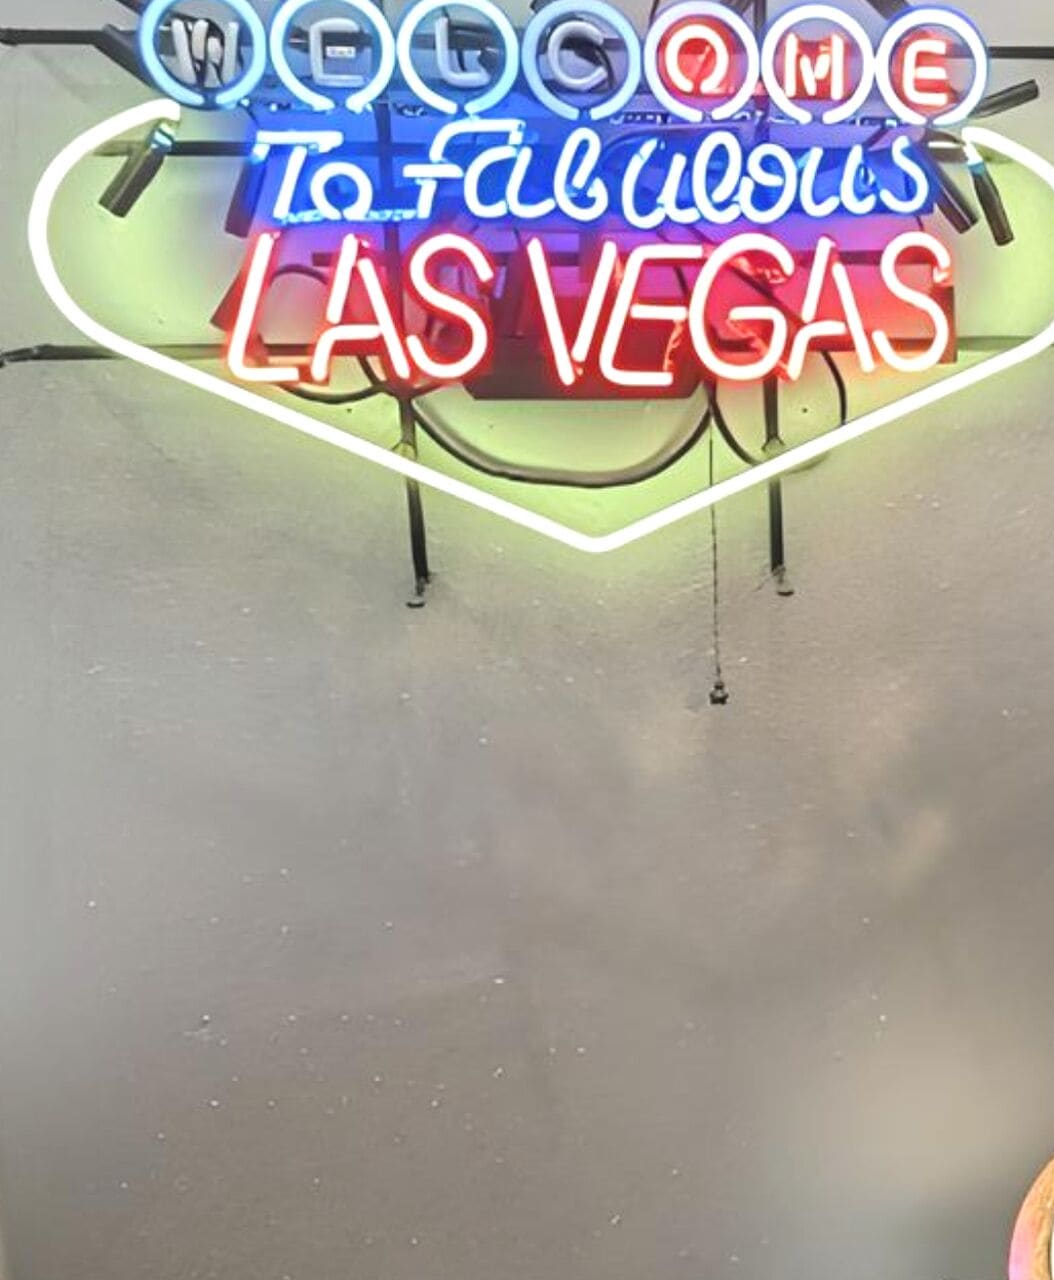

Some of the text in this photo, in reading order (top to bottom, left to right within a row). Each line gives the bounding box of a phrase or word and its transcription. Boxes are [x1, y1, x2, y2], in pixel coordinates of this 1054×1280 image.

[156, 12, 954, 110] WELCOME
[250, 129, 374, 221] To
[226, 230, 952, 388] LAS VEGAS
